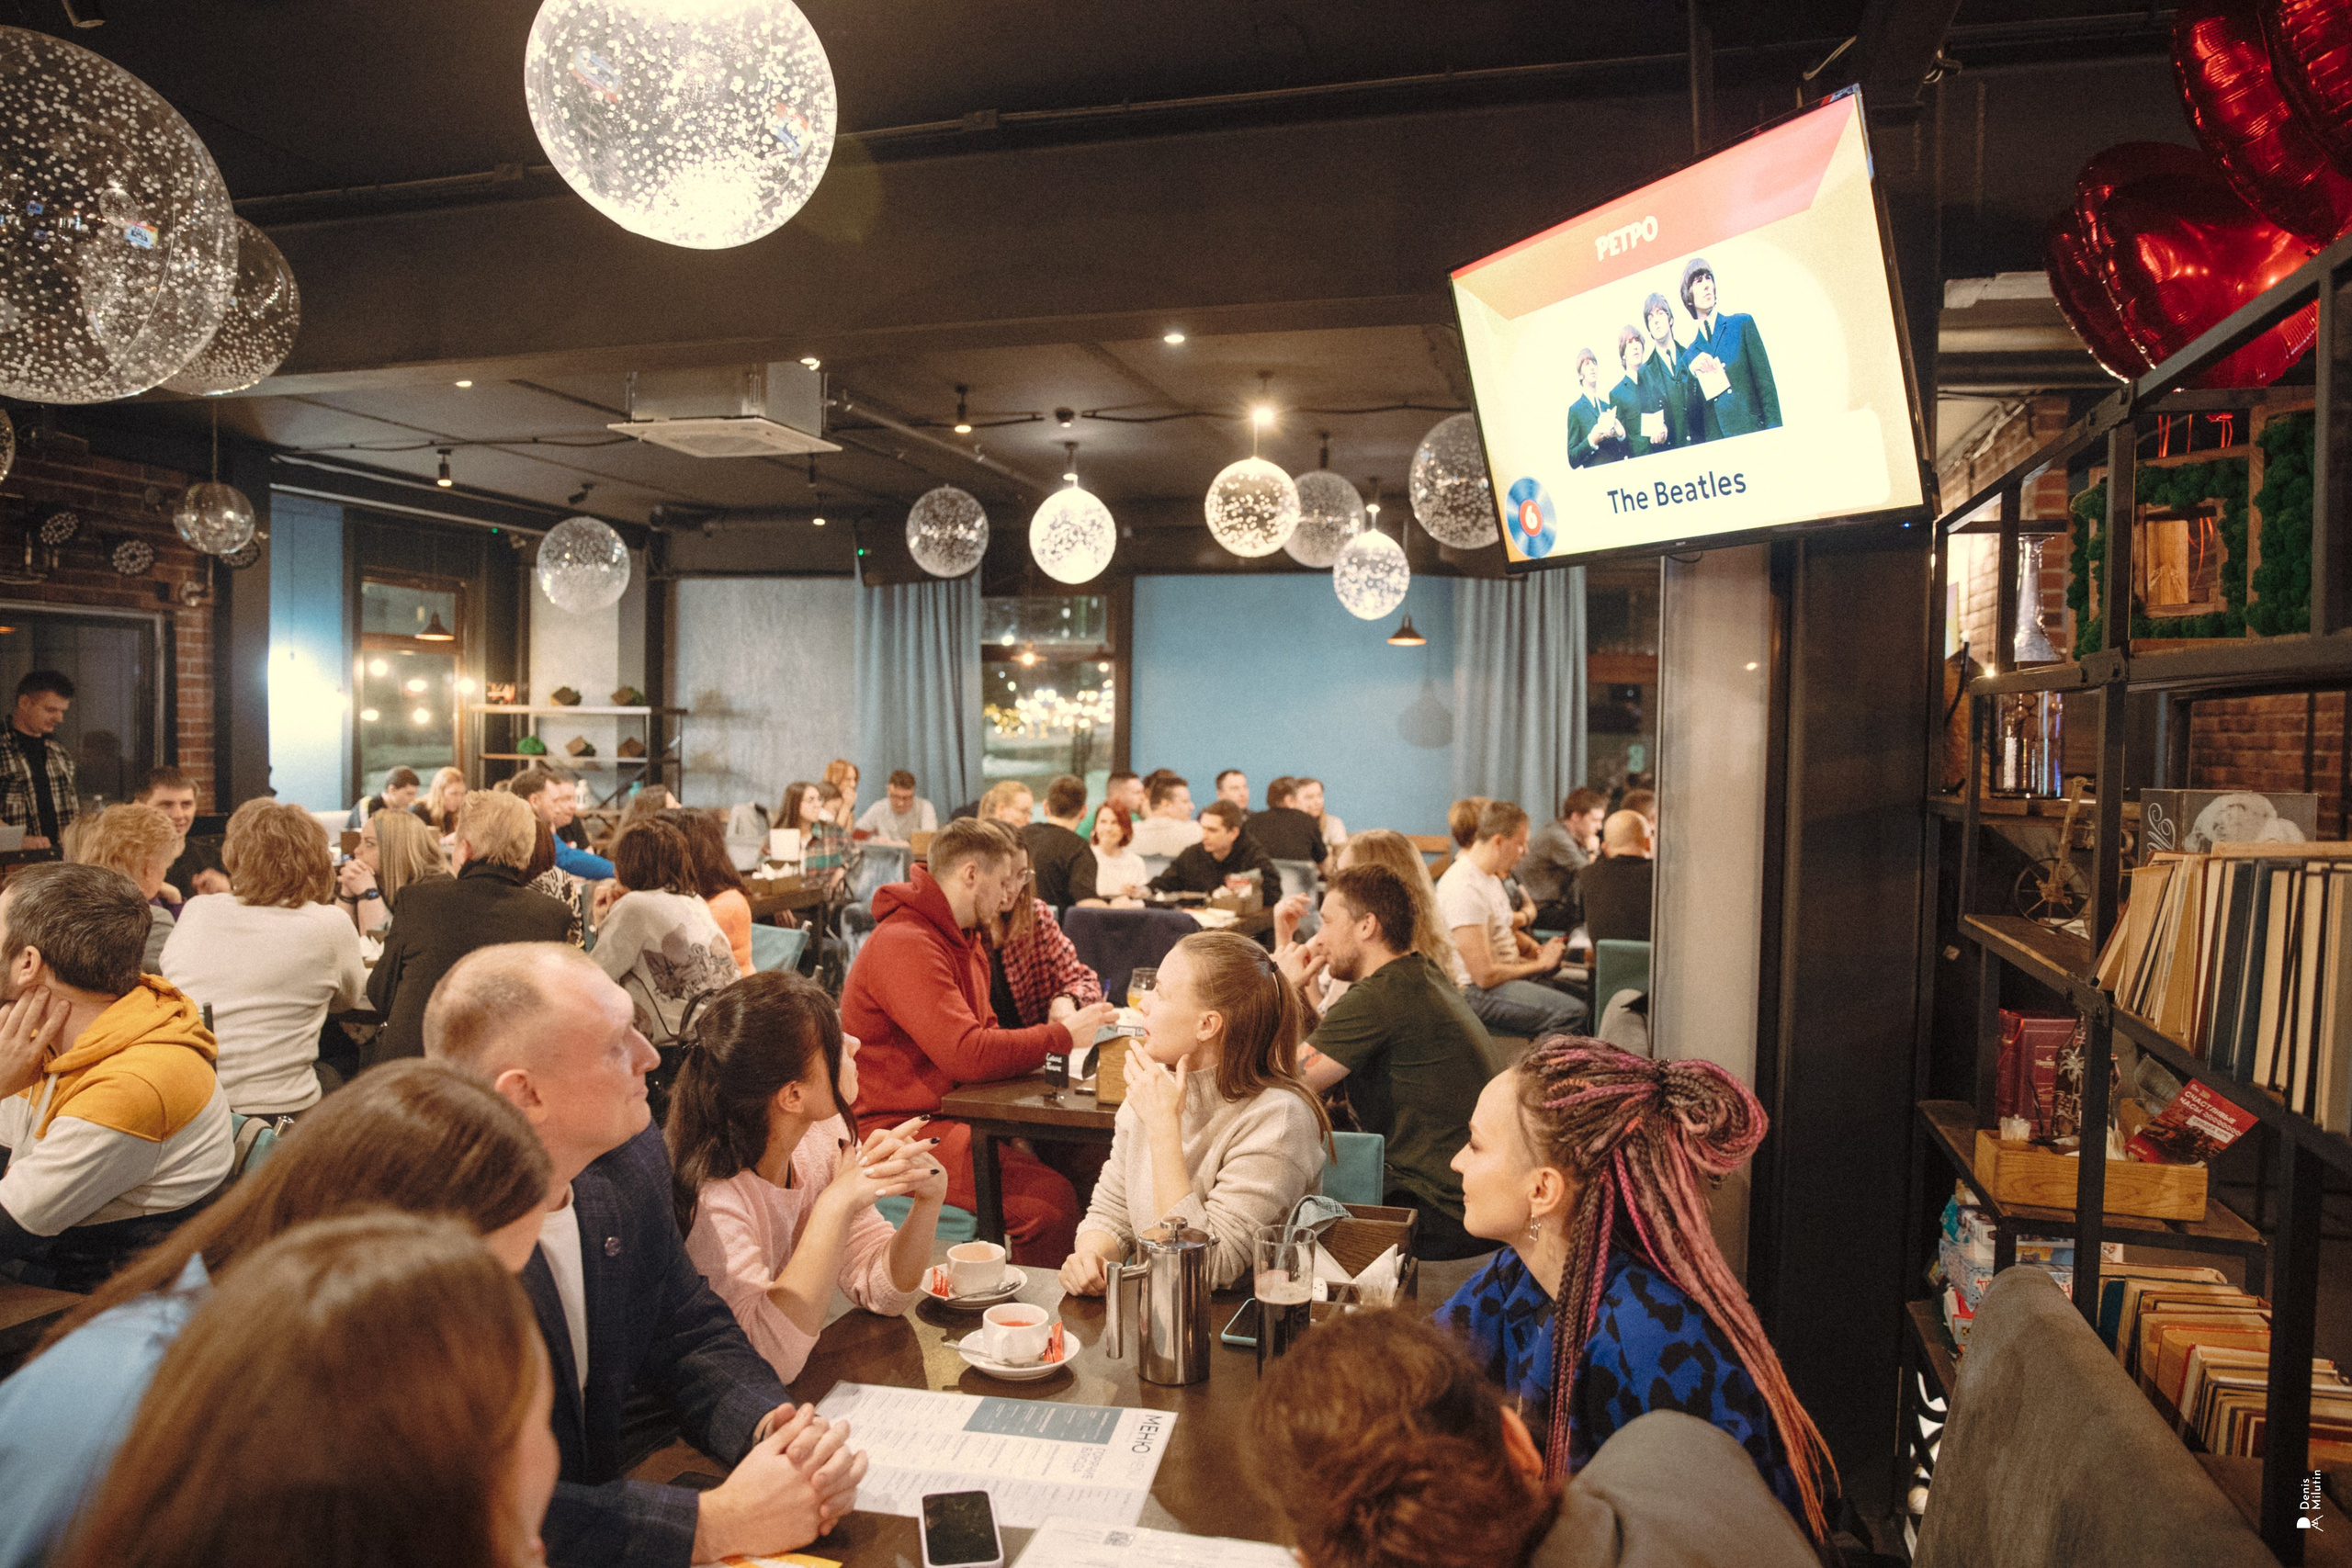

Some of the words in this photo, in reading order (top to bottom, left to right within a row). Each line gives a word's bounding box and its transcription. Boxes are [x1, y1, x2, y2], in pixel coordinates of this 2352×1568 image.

[1595, 216, 1658, 262] РЕТРО
[1607, 488, 1649, 514] The
[1654, 470, 1747, 506] Beatles
[1525, 505, 1538, 530] 6
[2180, 1097, 2203, 1113] ЧАСЫ
[2185, 1090, 2236, 1124] СЧАСТЛИВЫЕ
[2192, 1118, 2216, 1133] СКИДКА
[1131, 1415, 1162, 1453] МЕНЮ
